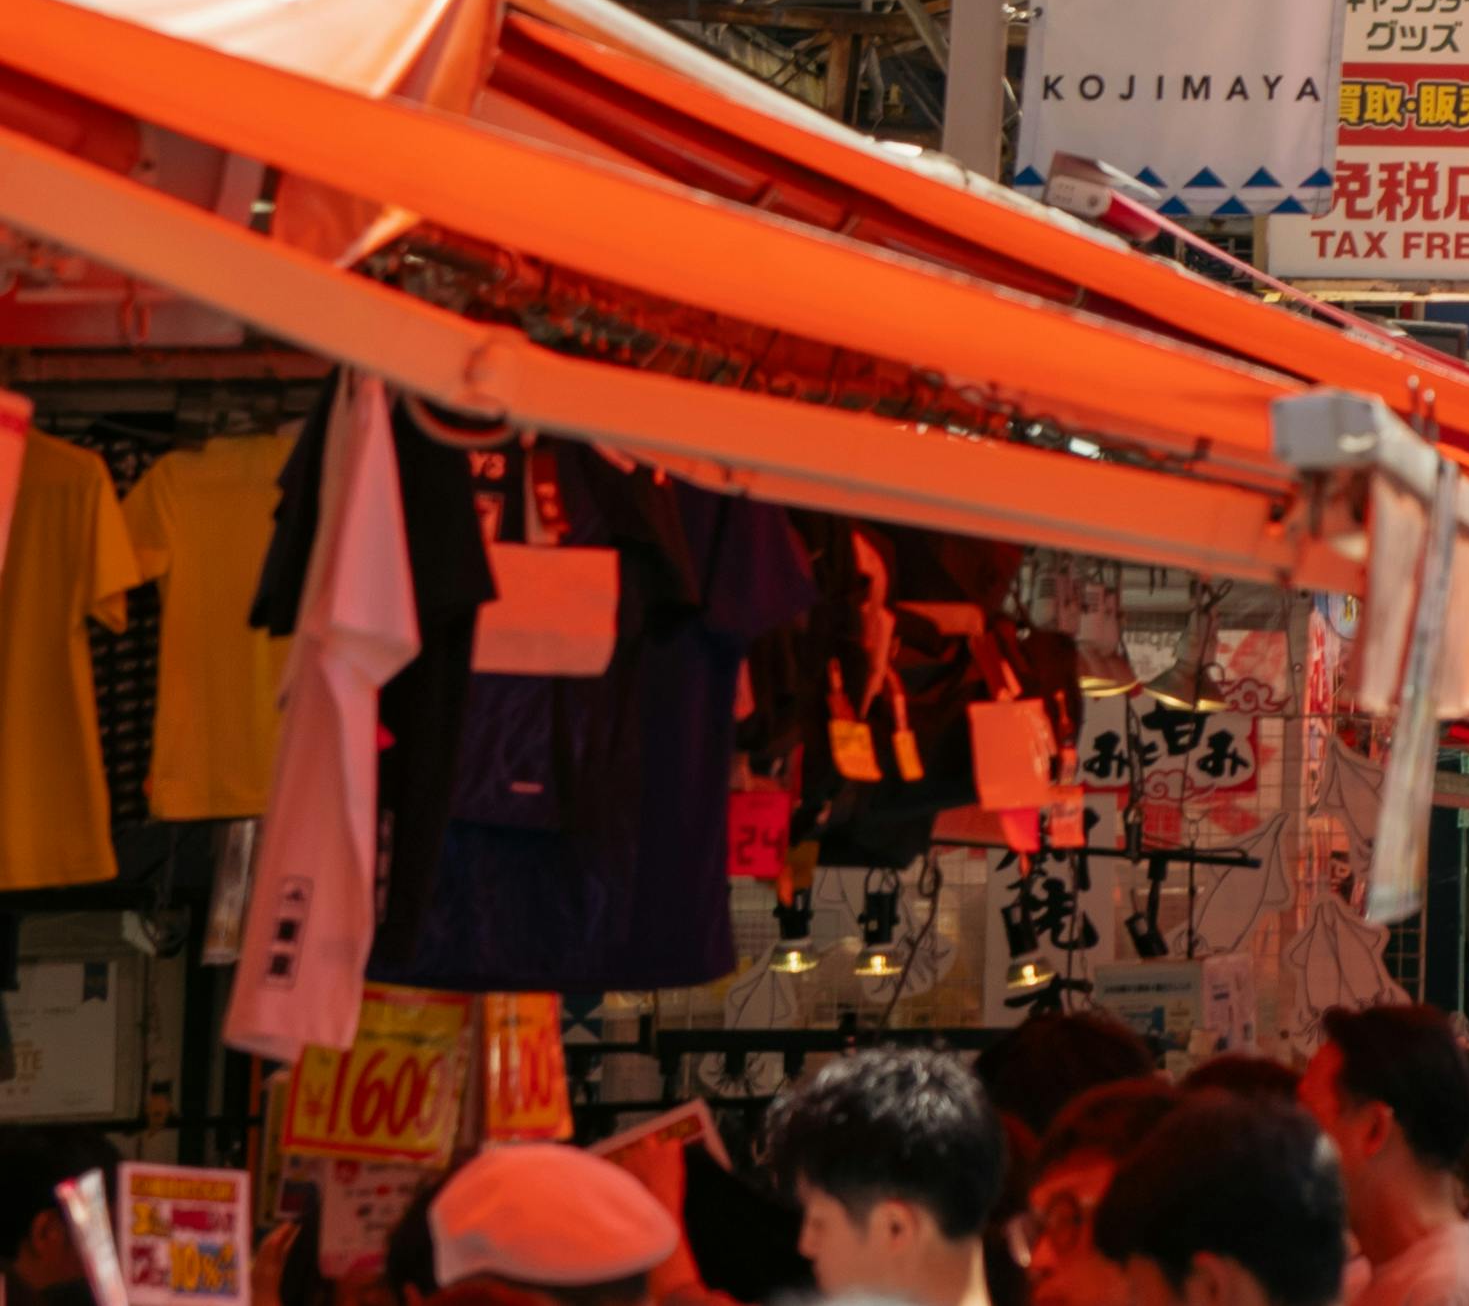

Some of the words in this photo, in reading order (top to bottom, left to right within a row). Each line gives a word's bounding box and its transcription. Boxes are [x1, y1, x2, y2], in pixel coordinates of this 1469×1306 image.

[1366, 20, 1463, 54] グッズ
[1043, 74, 1322, 103] KOJIMAYA
[1310, 230, 1388, 261] TAX
